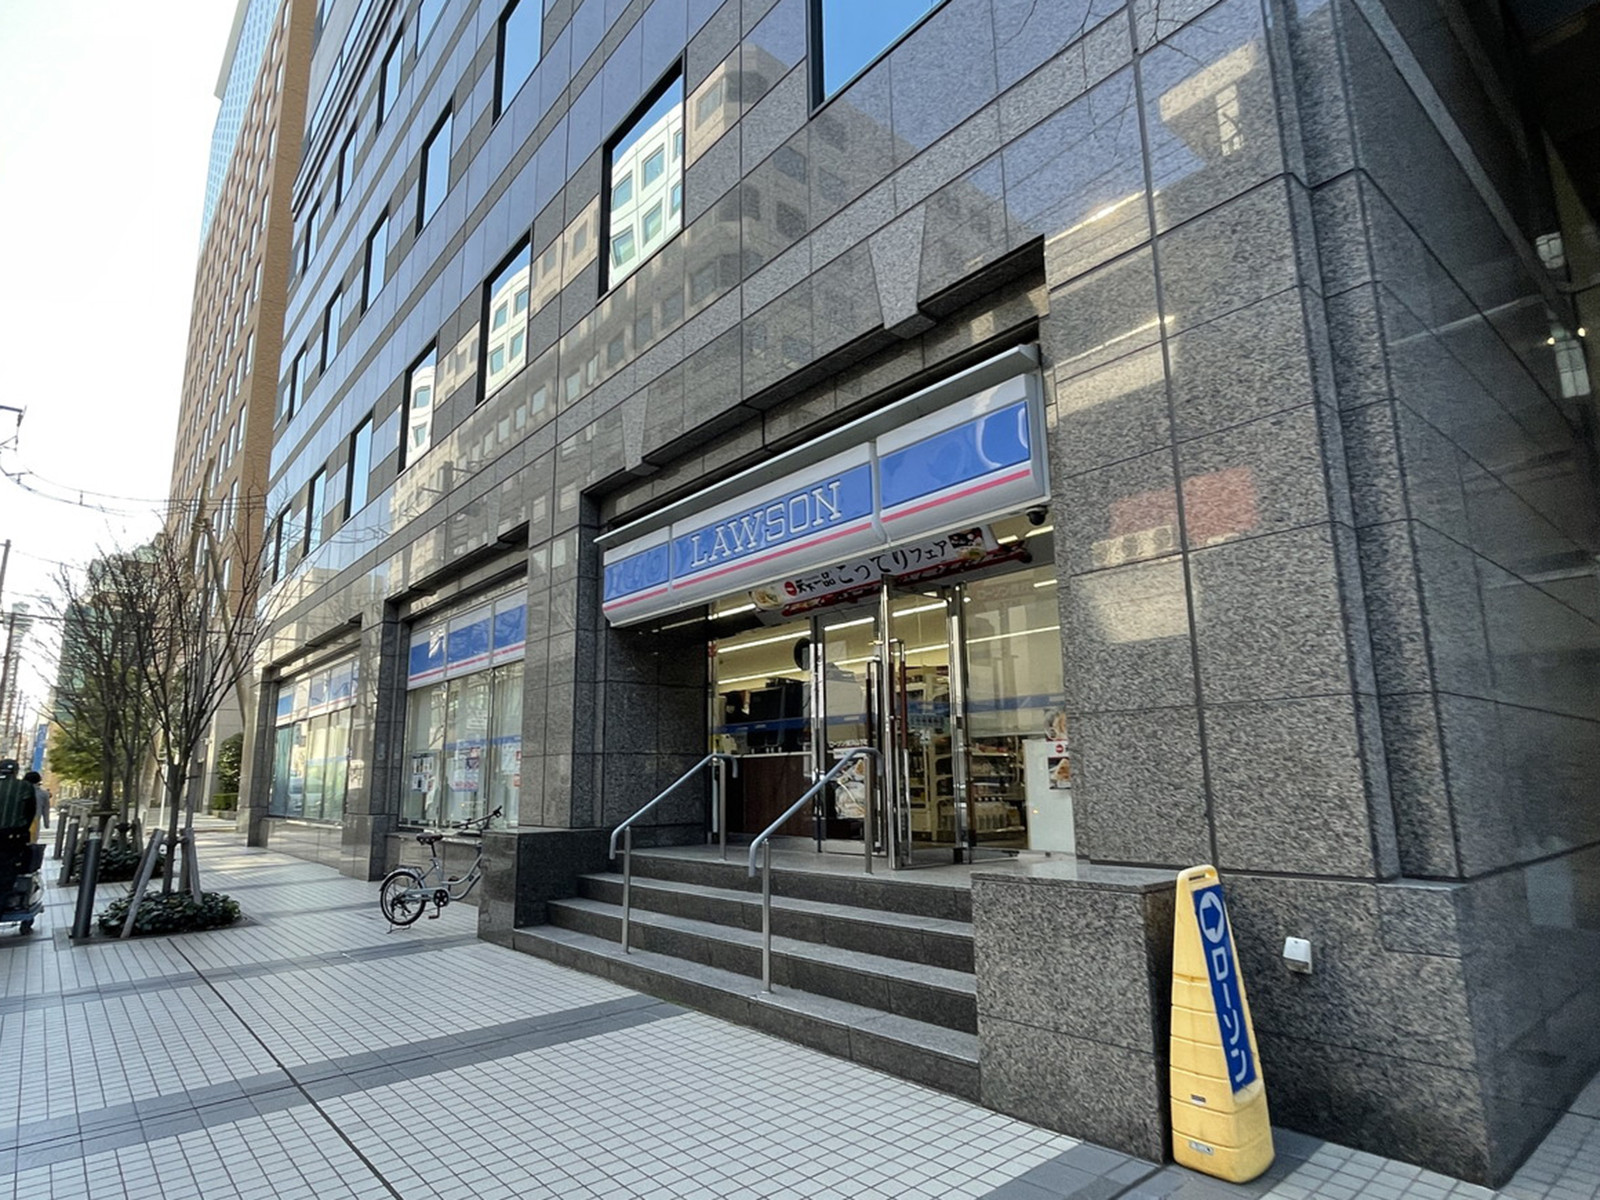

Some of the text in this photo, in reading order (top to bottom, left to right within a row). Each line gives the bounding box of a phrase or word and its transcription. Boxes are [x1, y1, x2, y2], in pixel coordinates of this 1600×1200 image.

[690, 480, 842, 568] LAWSON
[1211, 946, 1248, 1083] ローソン
